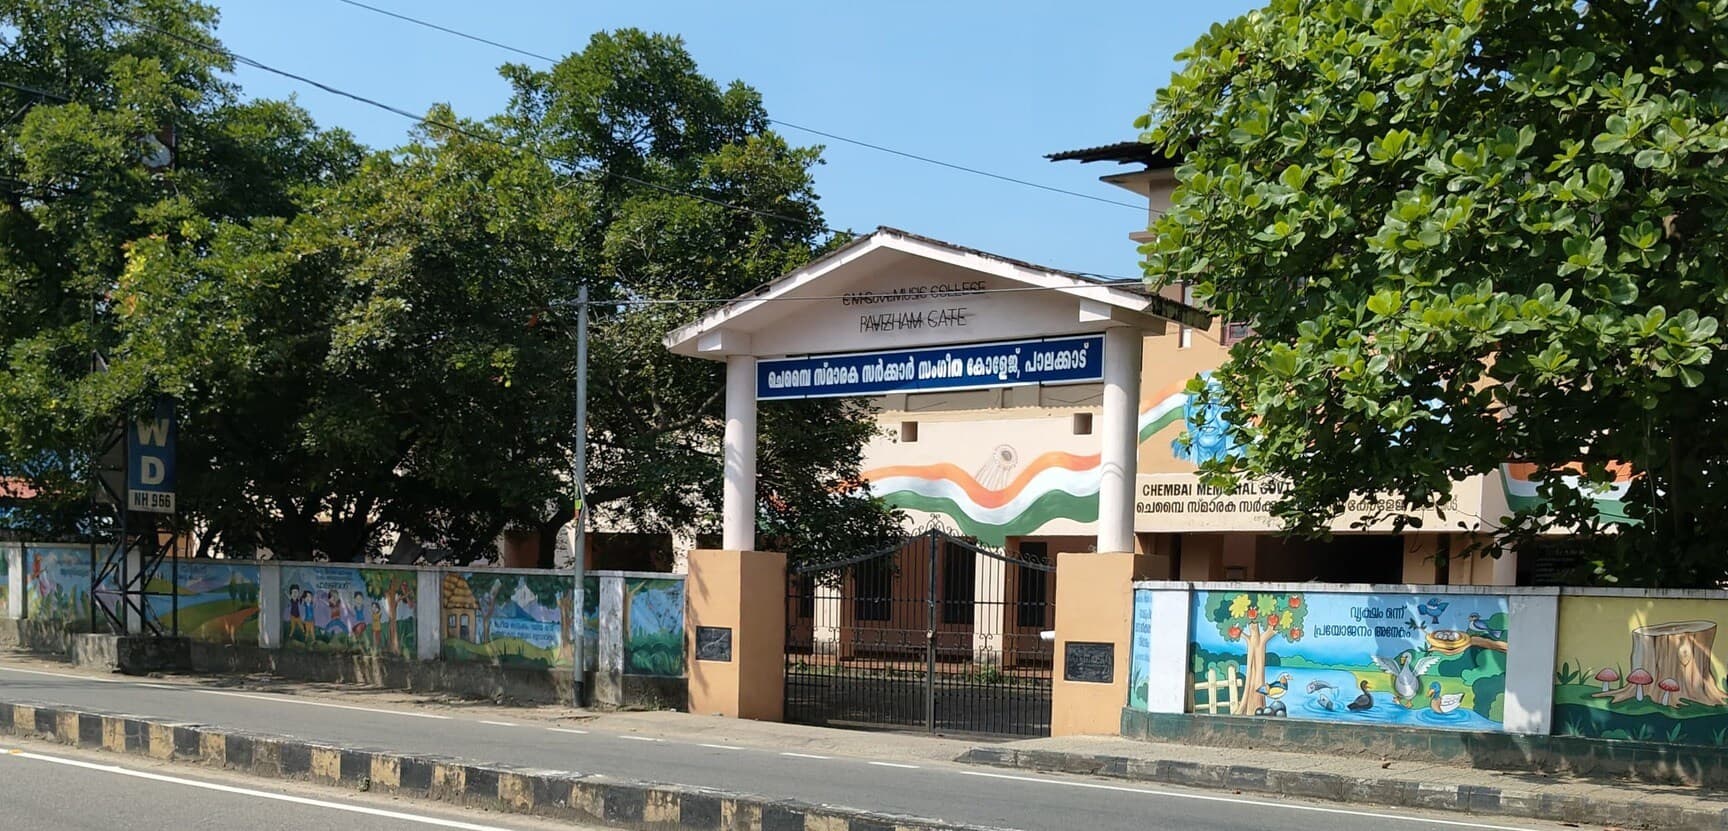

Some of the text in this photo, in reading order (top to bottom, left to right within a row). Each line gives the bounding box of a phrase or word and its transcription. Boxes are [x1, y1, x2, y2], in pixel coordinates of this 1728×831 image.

[927, 308, 968, 328] GATE
[768, 342, 1089, 388] ചെമ്പൈ സ്മാരക സർക്കാർ സംഗീത കോളേജ്, പാലക്കാട്
[1142, 483, 1192, 497] CHEMBAI
[1196, 482, 1257, 496] MEMIAL
[134, 492, 171, 508] NH 966
[1136, 501, 1184, 513] ചെമ്പൈ
[1187, 498, 1237, 513] സ്മാരക
[1350, 605, 1408, 622] വൃക്ഷം ഒന്ന്
[1313, 624, 1411, 638] പ്രയോജനം അനേകം
